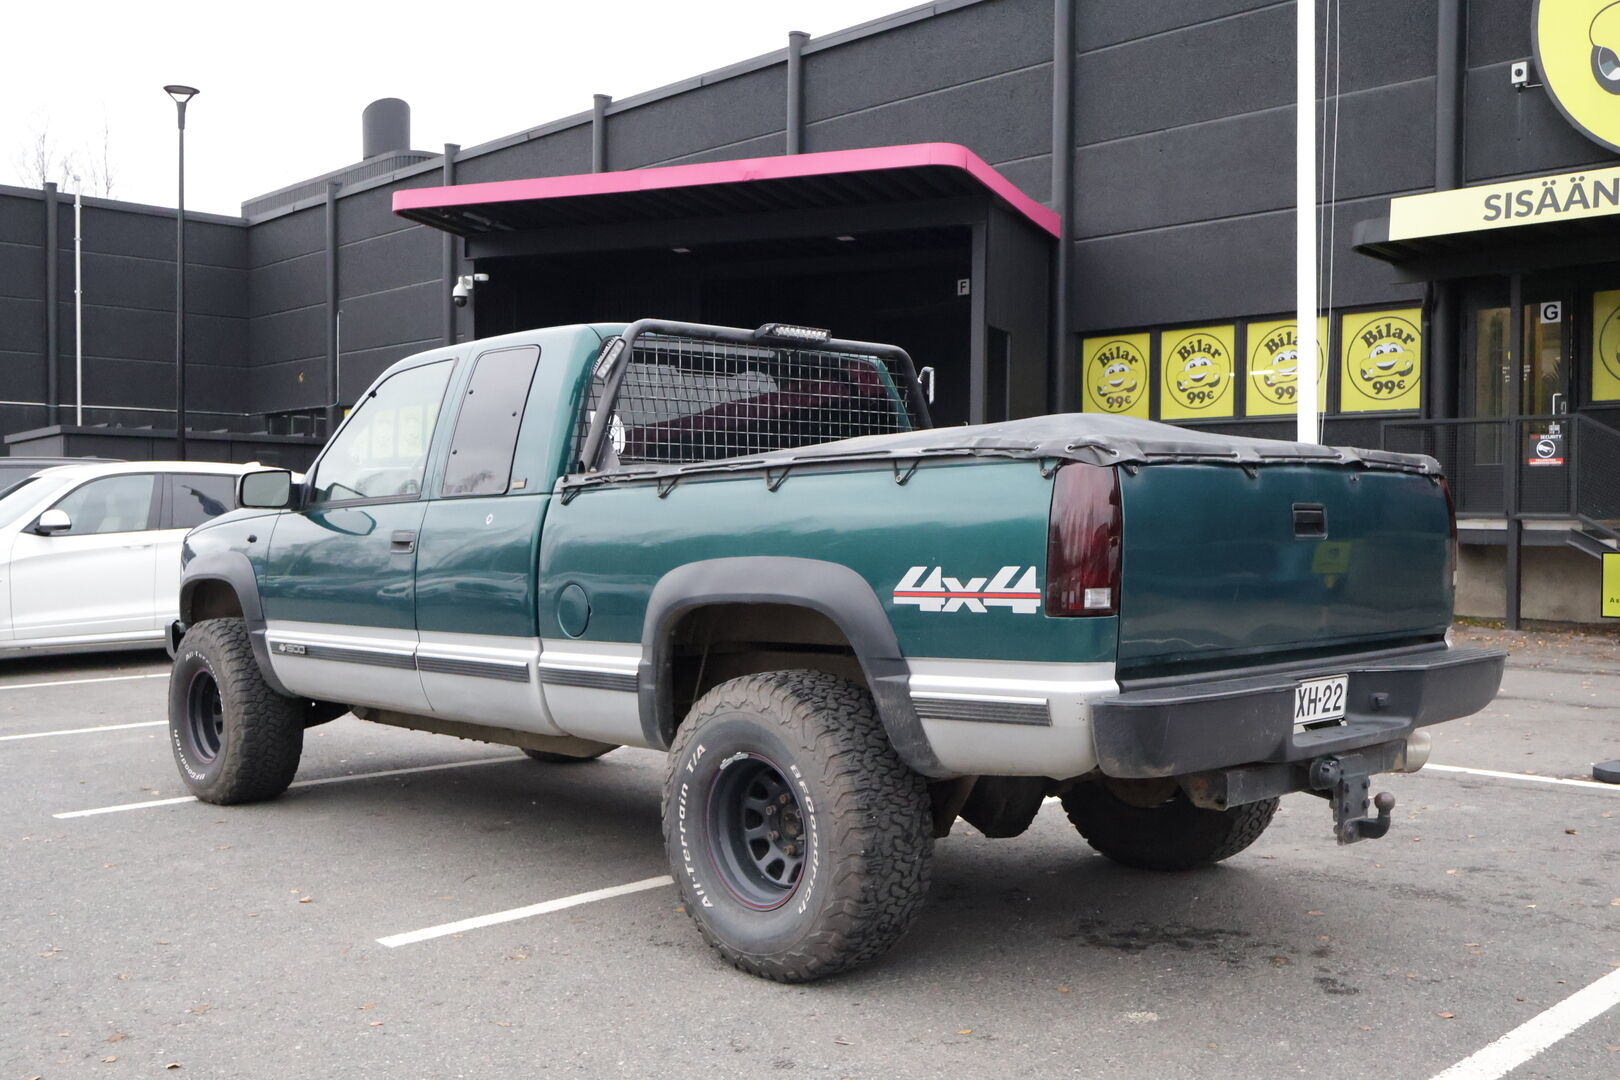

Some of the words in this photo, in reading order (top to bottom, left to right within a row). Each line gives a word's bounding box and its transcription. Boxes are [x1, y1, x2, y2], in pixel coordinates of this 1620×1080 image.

[1483, 175, 1619, 222] SISÄÄN
[960, 281, 967, 293] F
[1543, 304, 1559, 321] G
[1264, 331, 1298, 355] Bil
[1361, 323, 1416, 348] Bilar
[1097, 346, 1138, 368] Bilar
[1177, 339, 1222, 362] Bilar
[1187, 390, 1215, 404] 99€
[1274, 385, 1298, 400] 99
[1372, 380, 1406, 395] 99€
[1106, 395, 1132, 408] 99€
[893, 566, 1041, 613] 4x4
[1296, 683, 1343, 718] XH-22
[685, 744, 707, 774] T/A
[679, 783, 714, 908] All-Terrain
[790, 764, 819, 914] BFGoodrich
